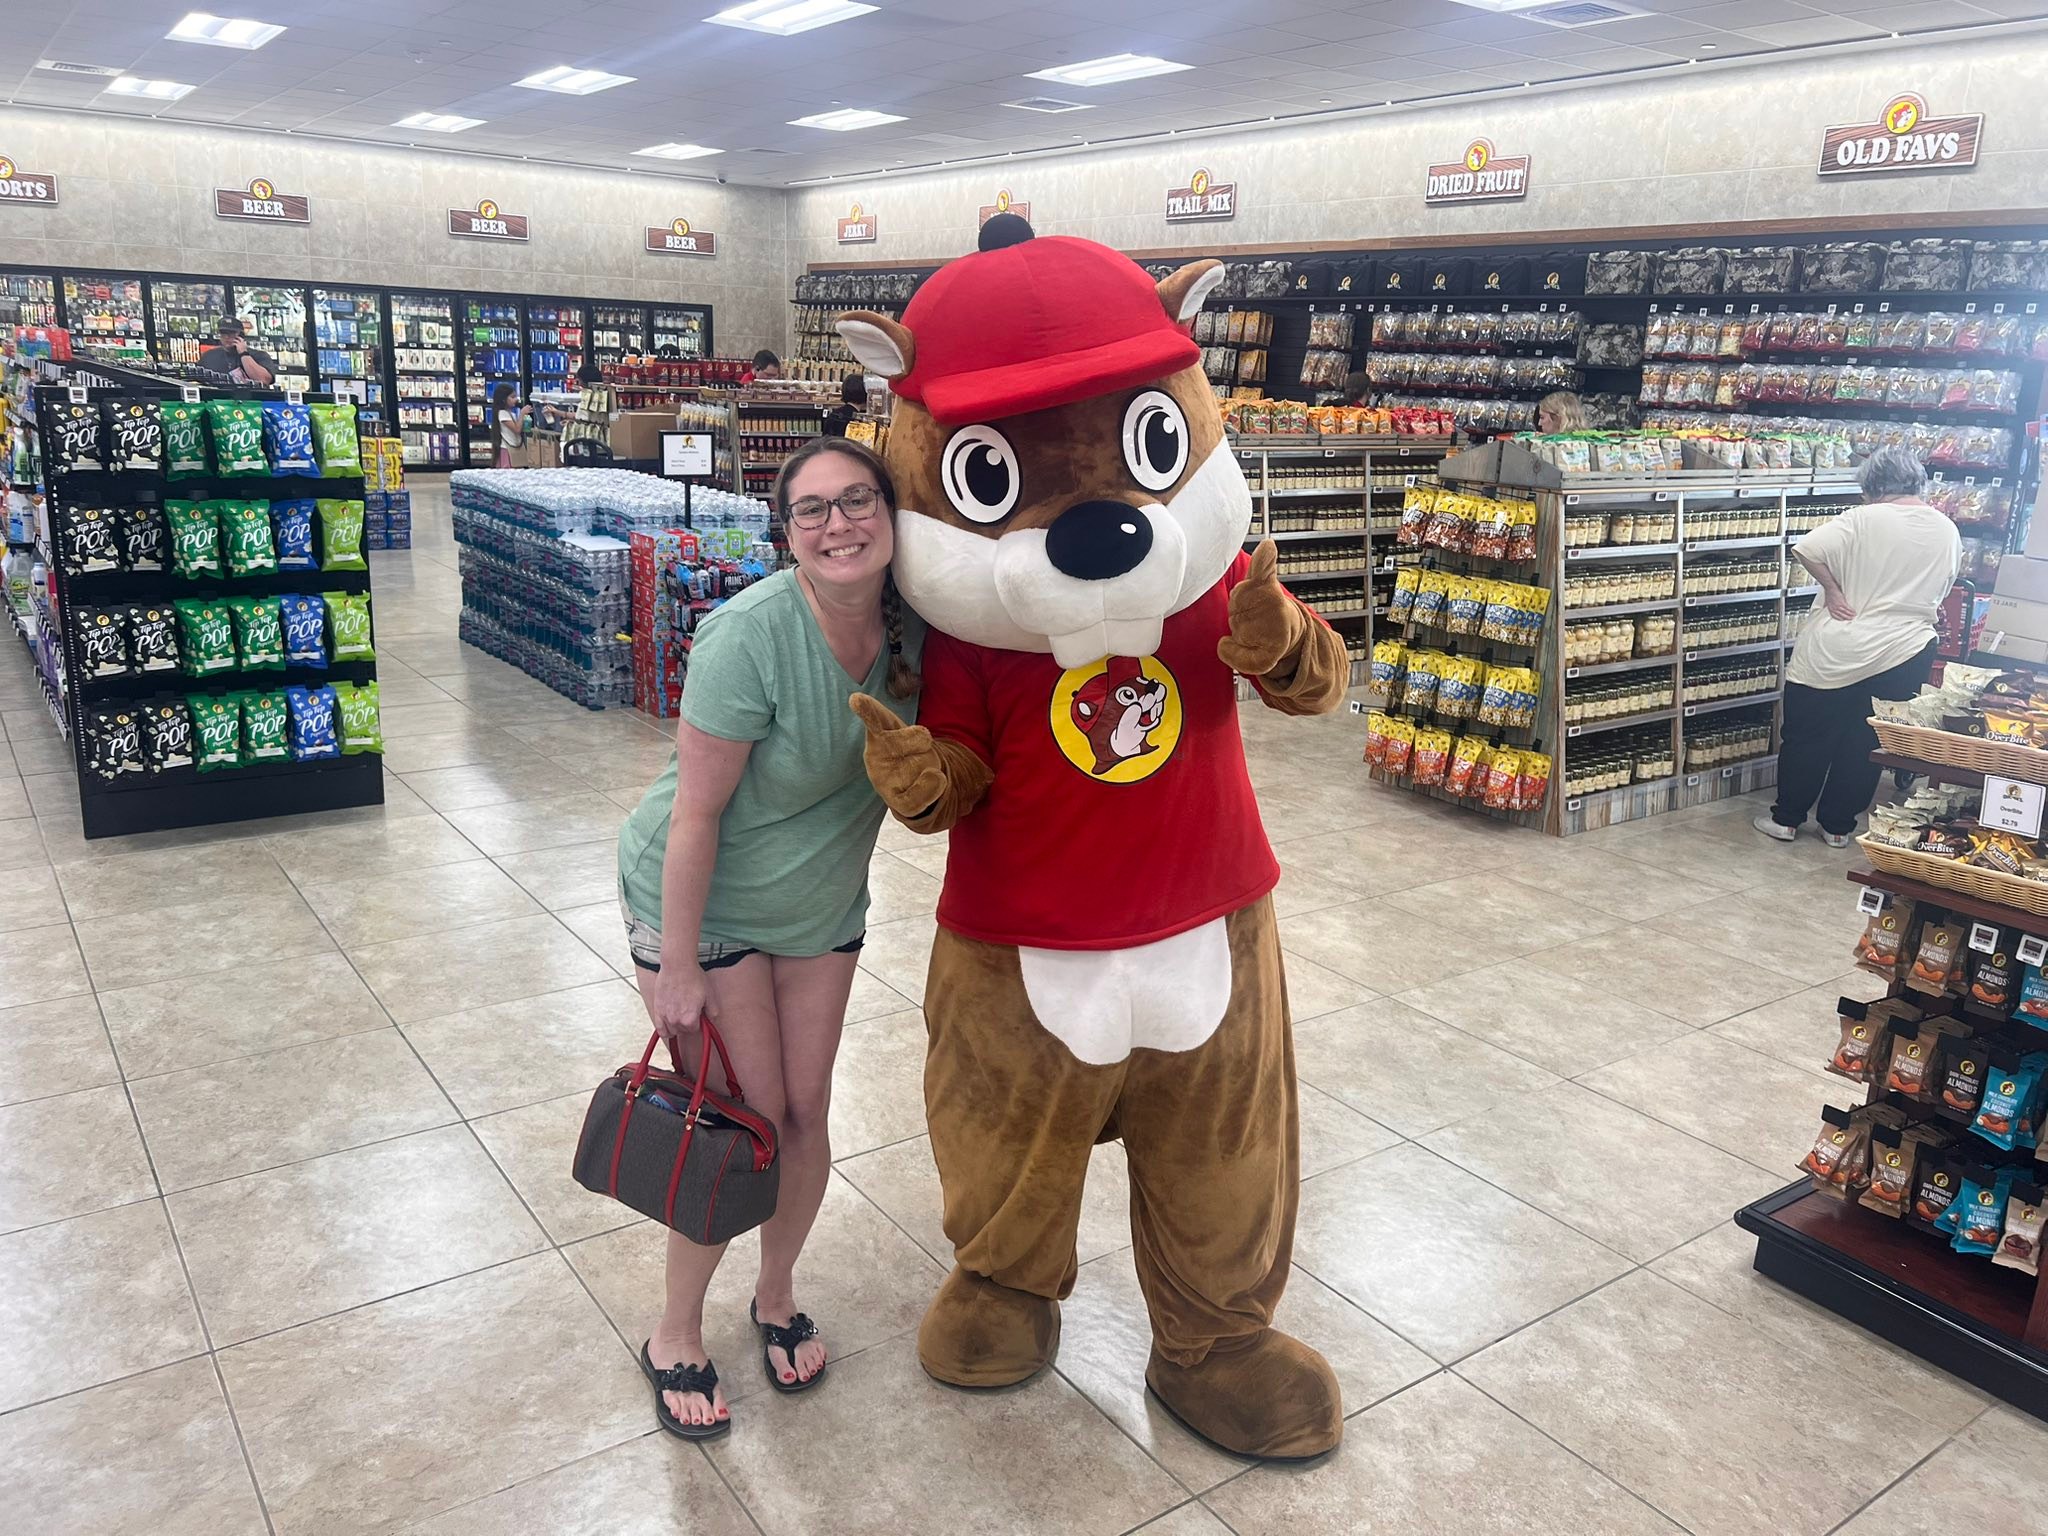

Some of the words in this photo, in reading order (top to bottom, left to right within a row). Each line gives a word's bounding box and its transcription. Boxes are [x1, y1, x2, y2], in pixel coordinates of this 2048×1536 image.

[1838, 138, 1889, 165] OLD
[1894, 132, 1960, 162] FAVS
[1428, 172, 1474, 198] DRIED
[1476, 168, 1524, 193] FRUIT
[242, 199, 285, 217] BEER
[1168, 196, 1203, 214] TRAIL
[1207, 193, 1231, 211] MIX
[470, 217, 508, 235] BEER
[844, 224, 867, 237] JERKY
[665, 235, 697, 250] BEER
[65, 421, 78, 430] Tip
[79, 417, 92, 427] Top
[122, 420, 135, 429] Tip
[136, 417, 149, 426] Top
[228, 423, 240, 431] Tip
[240, 421, 250, 429] Top
[278, 419, 288, 429] Tip
[288, 418, 300, 427] Top
[118, 425, 160, 449] POP
[168, 427, 200, 450] POP
[227, 429, 261, 450] POP
[278, 425, 309, 444] POP
[324, 429, 354, 449] POP
[77, 523, 89, 533] Tip
[89, 521, 104, 529] Top
[131, 524, 141, 533] Tip
[141, 521, 153, 529] Top
[185, 523, 195, 533] Tip
[196, 520, 208, 528] Top
[243, 522, 251, 531] Tip
[252, 520, 262, 529] Top
[291, 517, 302, 525] Top
[126, 529, 162, 552] POP
[181, 527, 217, 552] POP
[243, 526, 271, 550] POP
[278, 523, 310, 544] POP
[331, 523, 362, 546] POP
[725, 575, 743, 586] PRIME
[140, 624, 151, 633] Tip
[152, 621, 166, 630] Top
[201, 623, 210, 632] Tip
[210, 620, 220, 628] Top
[249, 619, 260, 628] Tip
[290, 615, 300, 623] Tip
[335, 614, 365, 635] POP
[88, 629, 100, 639] Tip
[102, 626, 115, 634] Top
[201, 625, 230, 649] POP
[248, 622, 279, 643] POP
[287, 619, 322, 643] POP
[254, 712, 264, 722] Tip
[266, 709, 277, 717] Top
[302, 709, 312, 718] Tip
[313, 705, 325, 714] Top
[344, 707, 375, 726] POP
[157, 722, 167, 732] Tip
[168, 716, 180, 726] Top
[206, 717, 217, 726] Tip
[218, 714, 230, 722] Top
[251, 715, 286, 739] POP
[300, 711, 332, 734] POP
[113, 728, 124, 737] Tip
[124, 723, 136, 732] Top
[154, 723, 190, 750] POP
[202, 721, 238, 744] POP
[1986, 730, 2030, 745] OverBite
[2001, 818, 2018, 827] $2.79
[1986, 843, 2021, 872] OverBite
[1871, 933, 1899, 948] ALMONDS
[1920, 948, 1949, 963] ALMONDS
[1977, 971, 2007, 986] ALMONDS
[1894, 1060, 1922, 1076] ALMONDS
[1947, 1078, 1978, 1094] ALMONDS
[1983, 1101, 2014, 1117] ALMONDS
[1920, 1189, 1951, 1206] ALMONDS
